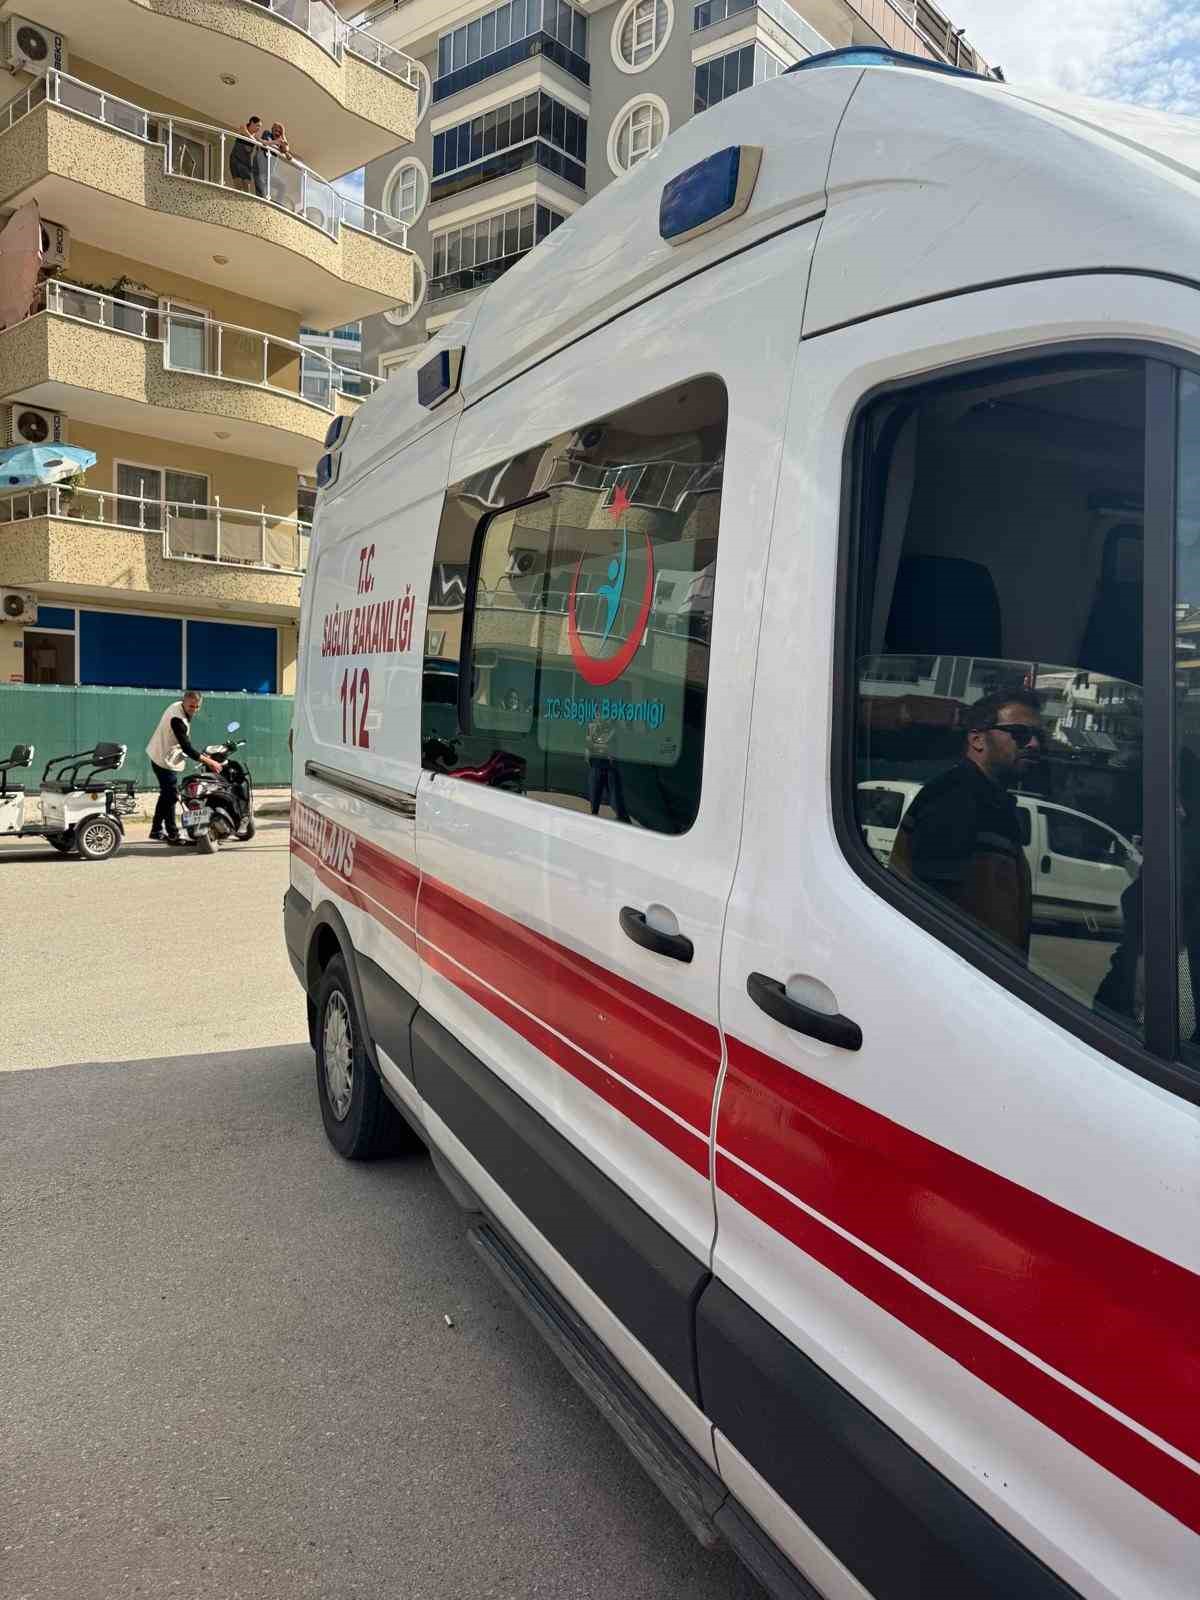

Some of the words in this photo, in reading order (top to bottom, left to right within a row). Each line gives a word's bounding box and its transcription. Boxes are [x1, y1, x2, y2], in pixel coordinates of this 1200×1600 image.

[320, 602, 352, 657] SAĞLIK
[351, 584, 415, 655] BAKANLIĞI
[340, 668, 370, 748] 112
